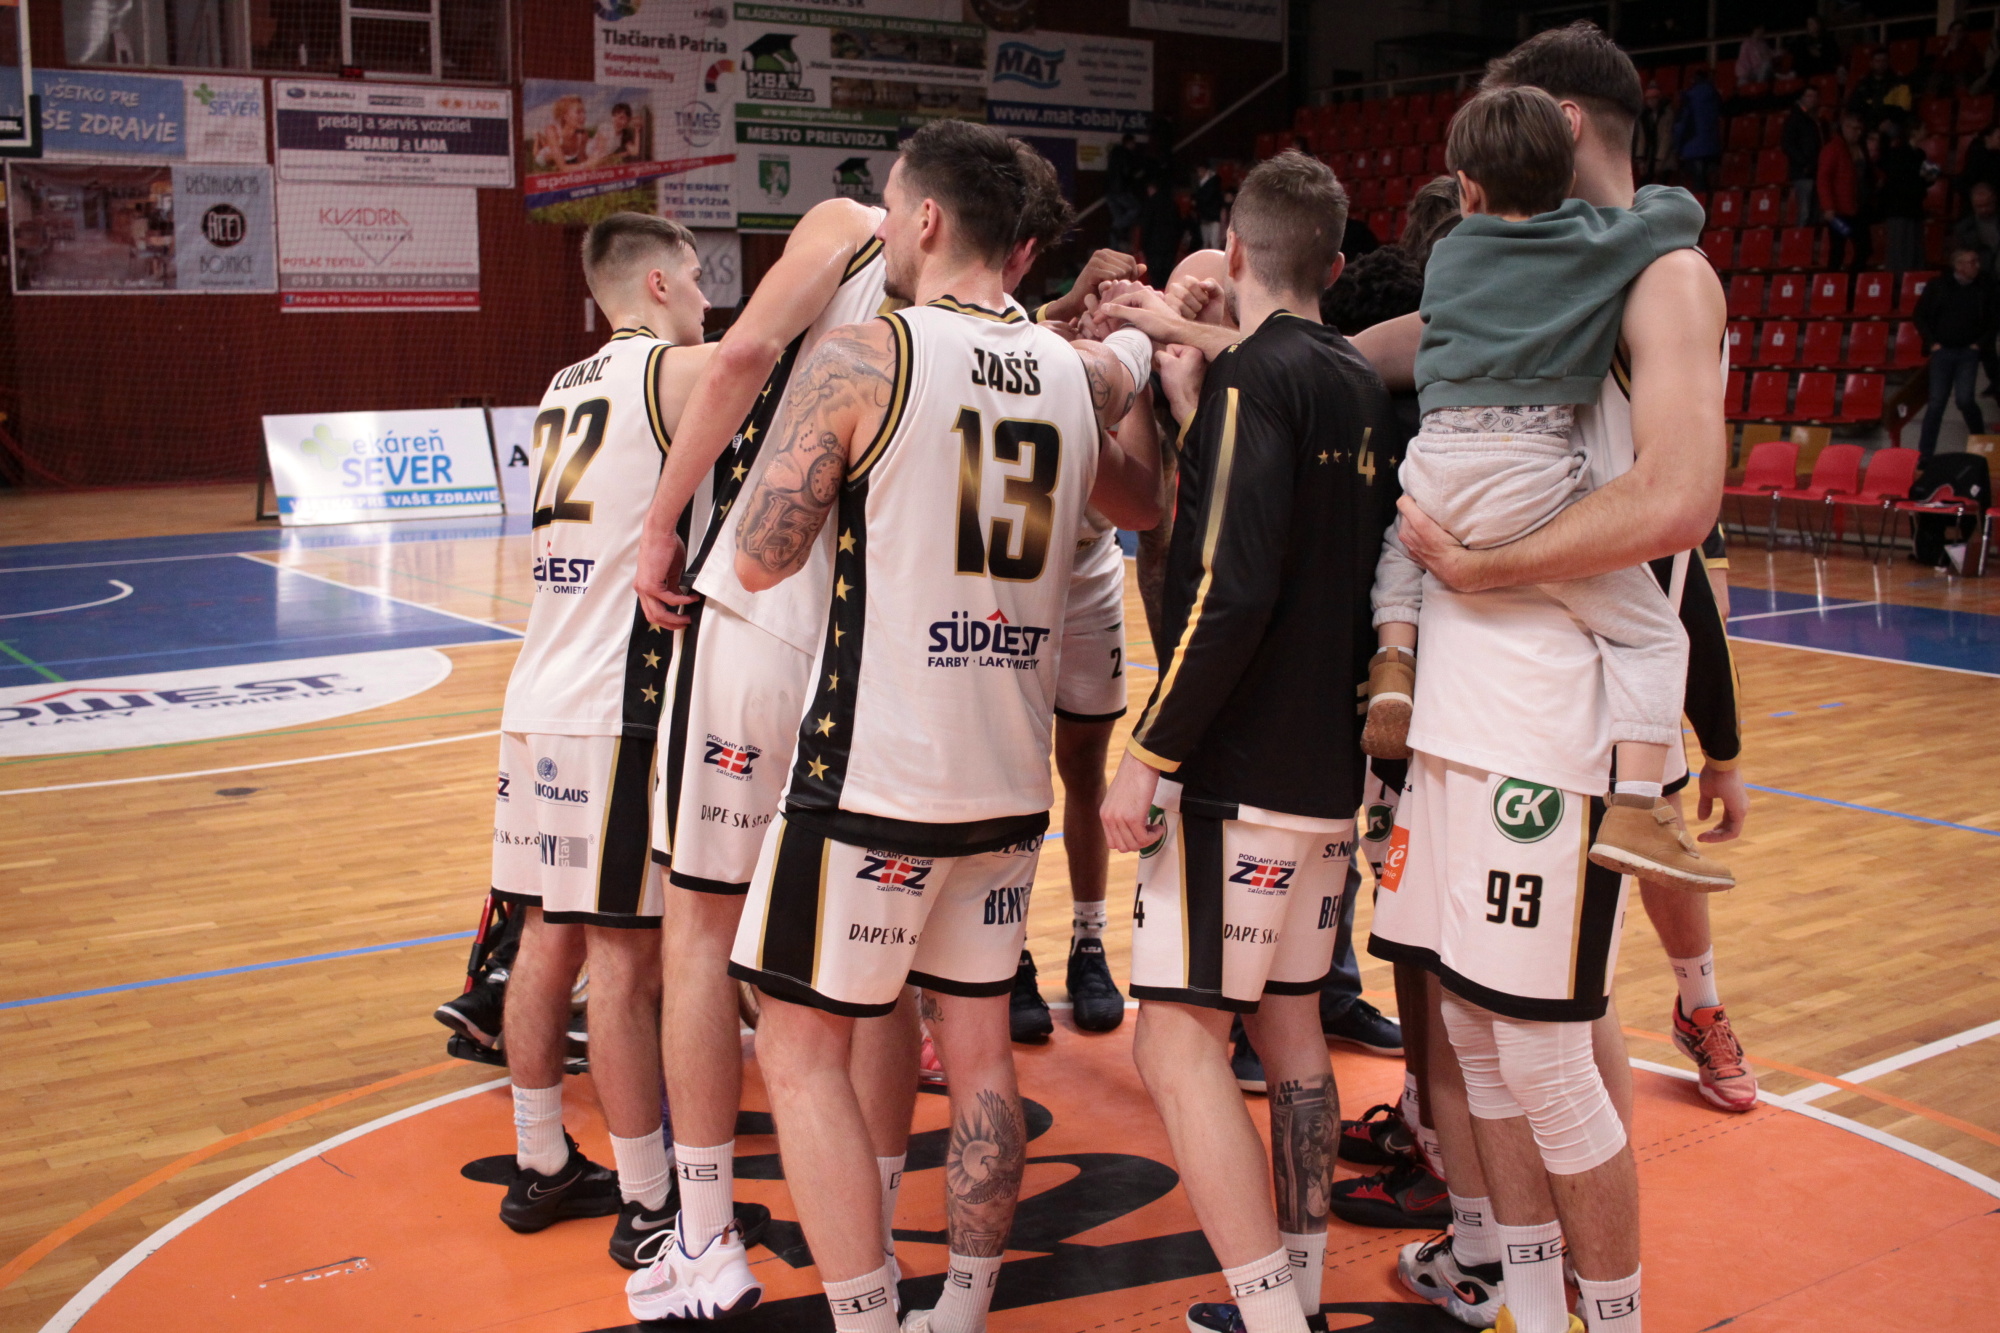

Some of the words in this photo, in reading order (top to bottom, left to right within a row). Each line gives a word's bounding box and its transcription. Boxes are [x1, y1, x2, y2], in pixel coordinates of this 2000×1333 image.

[602, 28, 676, 50] Tlačiareň
[679, 36, 728, 53] Patria
[996, 48, 1062, 82] MAT
[750, 72, 794, 88] MBA
[44, 78, 105, 103] VŠETKO
[109, 90, 141, 108] PRE
[208, 100, 260, 116] SEVER
[992, 105, 1148, 131] www.mat-obaly.sk
[317, 116, 363, 132] predaj
[378, 118, 416, 129] servis
[422, 120, 471, 132] vozidiel
[674, 110, 722, 130] TIMES
[345, 135, 399, 150] SUBARU
[403, 140, 411, 150] a
[414, 137, 448, 152] LADA
[746, 126, 801, 142] MESTO
[805, 131, 887, 147] PRIEVIDZA
[664, 183, 729, 192] INTERNET
[664, 196, 730, 206] TELEVÍZIA
[319, 207, 411, 226] KVADRA
[971, 347, 1042, 396] JAŠŠ
[532, 397, 613, 532] 22
[1357, 427, 1376, 487] 4
[342, 455, 453, 488] SEVER
[391, 491, 431, 507] VAŠE
[433, 488, 499, 505] ZDRAVIE
[951, 404, 1063, 584] 13
[928, 656, 969, 668] FARBY
[707, 733, 738, 750] PODLAHY
[701, 804, 730, 824] DAPE
[732, 813, 751, 828] SK
[1504, 787, 1555, 827] GK
[1239, 853, 1273, 865] PODLAHY
[1133, 883, 1145, 928] 4
[1486, 870, 1543, 928] 93
[849, 923, 889, 945] DAPE
[890, 927, 908, 944] SK
[1224, 923, 1259, 944] DAPE
[1260, 929, 1274, 944] SK
[1234, 1263, 1293, 1298] BC
[831, 1287, 887, 1316] BC
